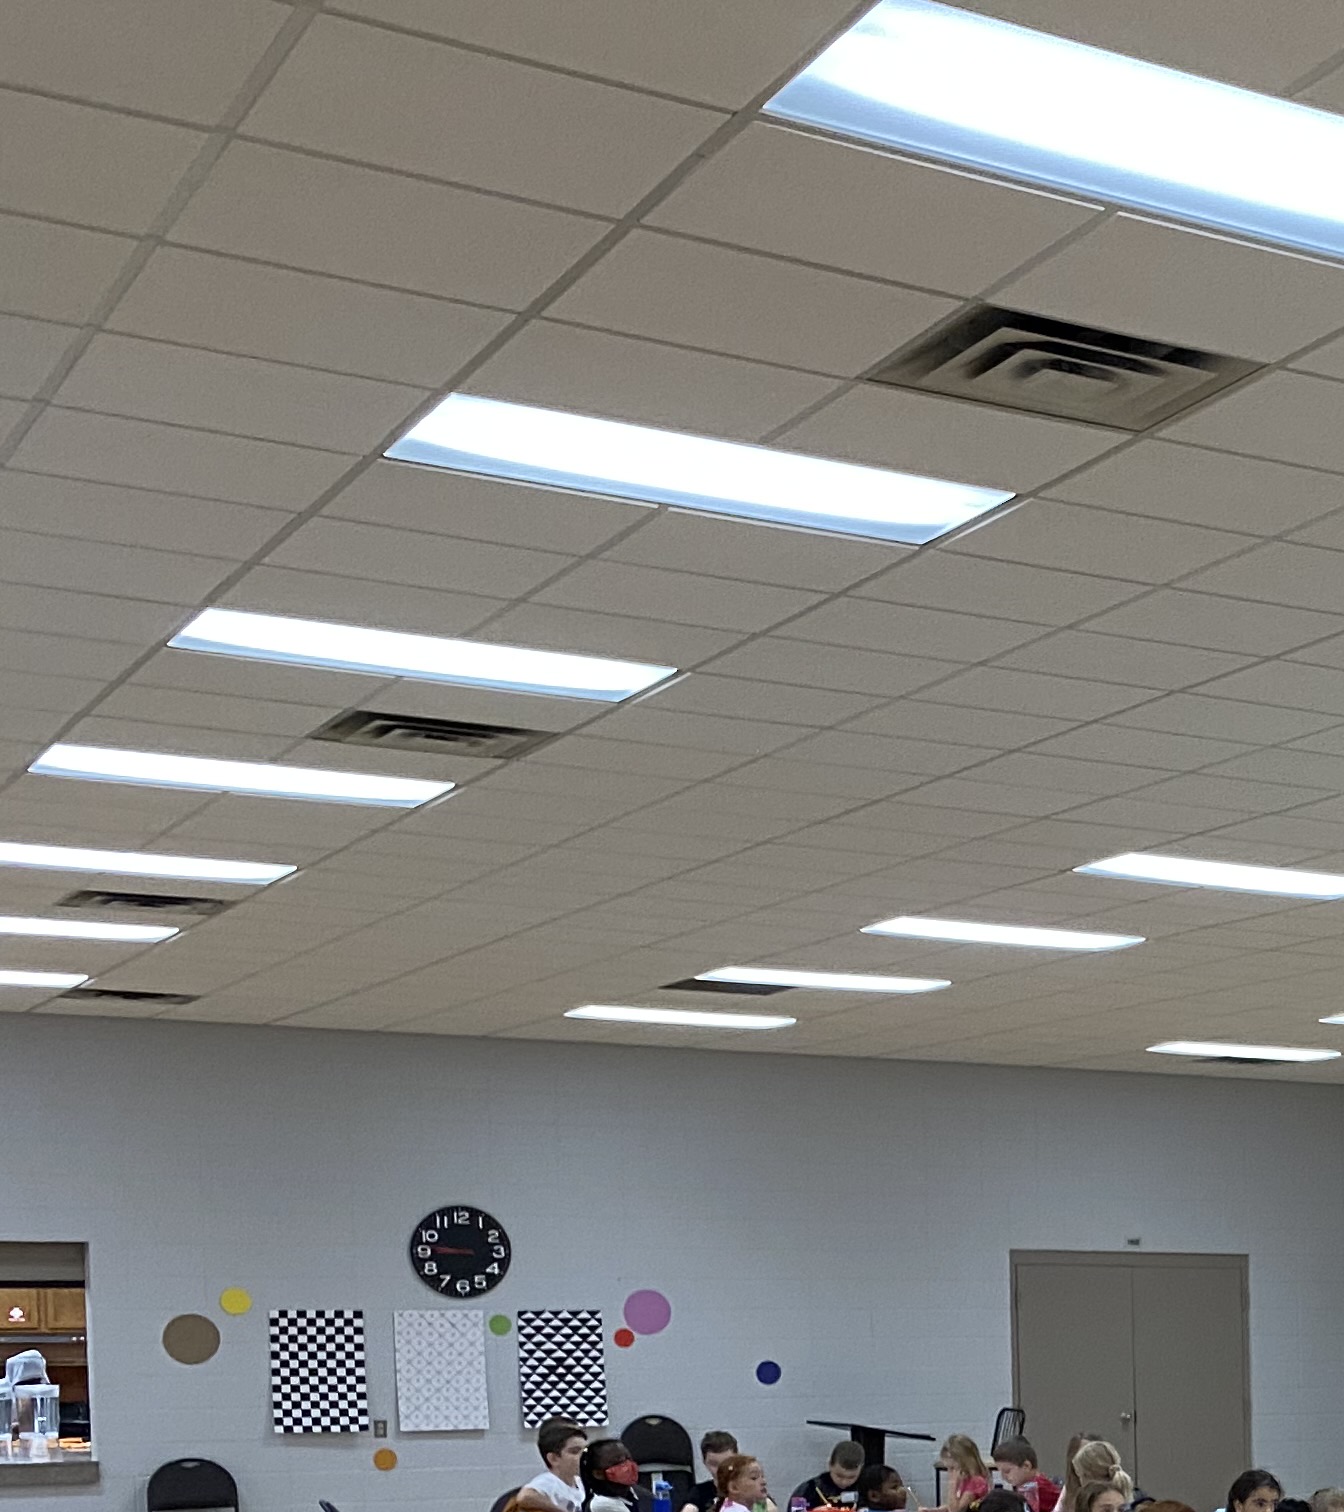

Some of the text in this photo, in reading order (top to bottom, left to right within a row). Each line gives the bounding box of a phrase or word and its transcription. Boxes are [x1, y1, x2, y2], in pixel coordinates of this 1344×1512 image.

[436, 1213, 448, 1229] 11
[454, 1210, 470, 1225] 12
[422, 1229, 439, 1243] 10
[487, 1229, 499, 1243] 2
[417, 1244, 432, 1258] 9
[492, 1245, 505, 1258] 3
[424, 1261, 438, 1275] 8
[485, 1262, 499, 1275] 4
[440, 1274, 451, 1288] 7
[456, 1280, 470, 1292] 6
[474, 1275, 486, 1288] 5
